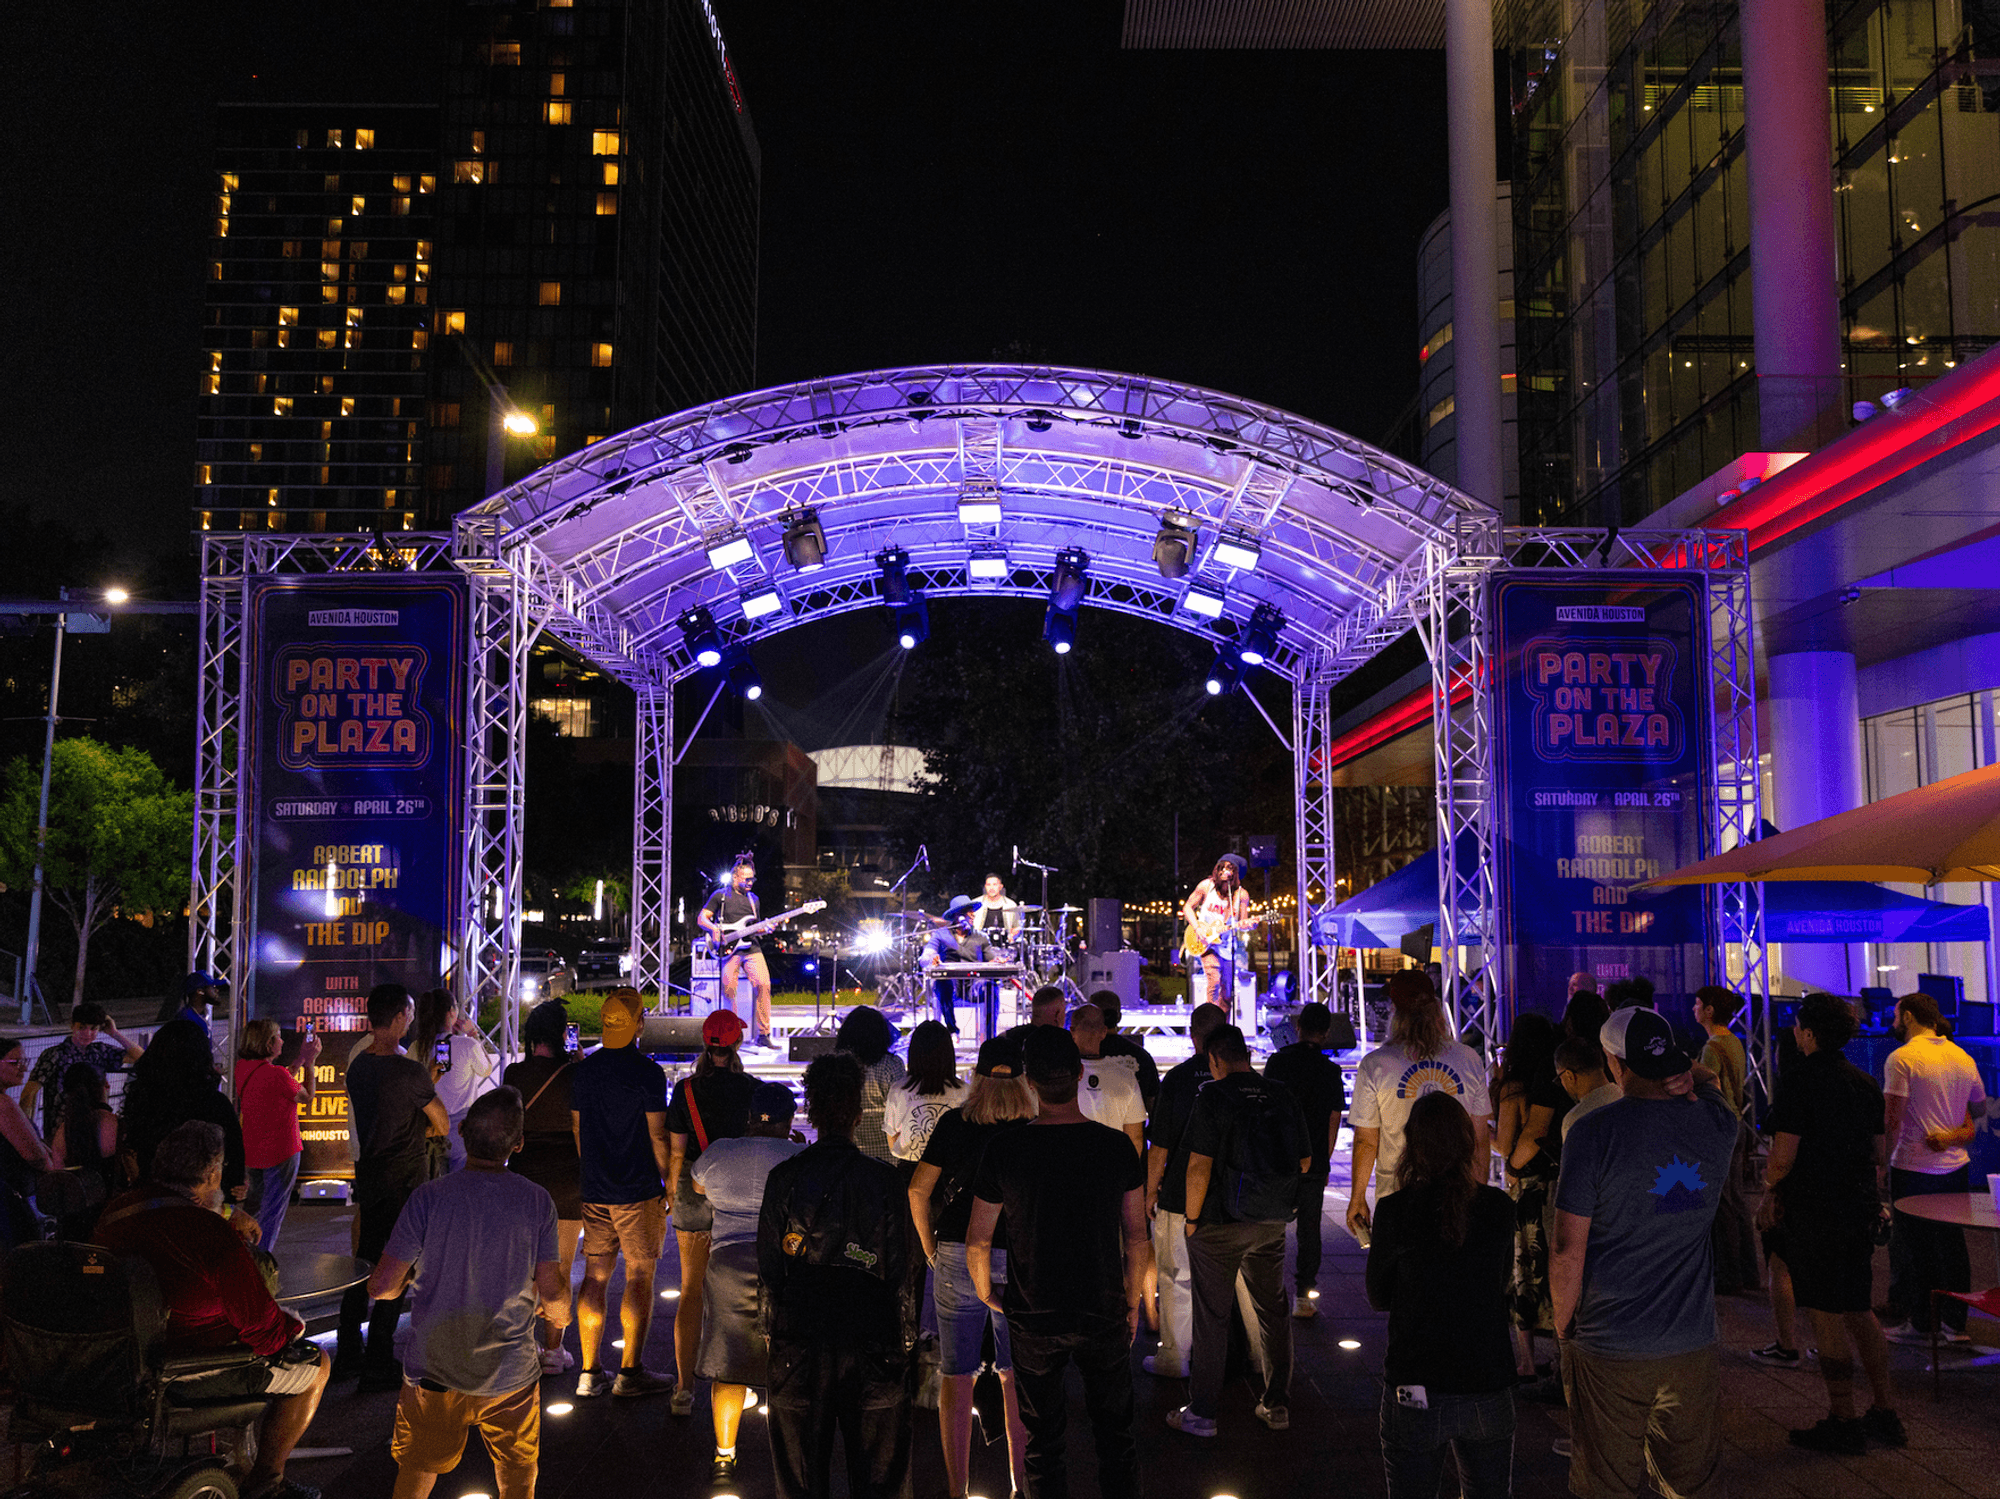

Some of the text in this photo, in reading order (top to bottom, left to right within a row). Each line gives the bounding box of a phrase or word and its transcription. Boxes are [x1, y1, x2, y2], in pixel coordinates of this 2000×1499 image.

[310, 611, 398, 624] AVENIDA HOUSTON
[1558, 608, 1644, 620] AVENIDA HOUSTON
[287, 658, 414, 691] PARTY
[1538, 652, 1662, 685] PARTY
[301, 693, 403, 717] ON THE
[1555, 687, 1655, 711] ON THE
[293, 720, 417, 753] PLAZA
[1549, 713, 1670, 746] PLAZA
[275, 799, 425, 816] SATURDAY APRIL 26TH
[1534, 792, 1599, 806] SATURDAY
[1614, 792, 1650, 806] APRIL
[313, 844, 384, 864] ROBERT
[1576, 836, 1644, 854] ROBERT
[292, 867, 398, 890] RANDOLPH
[1557, 858, 1660, 879] RANDOLPH
[1593, 886, 1628, 905] AND
[1571, 910, 1655, 933] THE DIP
[1835, 919, 1883, 933] HOUSTON
[304, 921, 390, 946] THE DIP
[325, 976, 359, 990] WITH
[296, 1015, 372, 1033] AEXAND
[311, 1096, 349, 1116] LIVE
